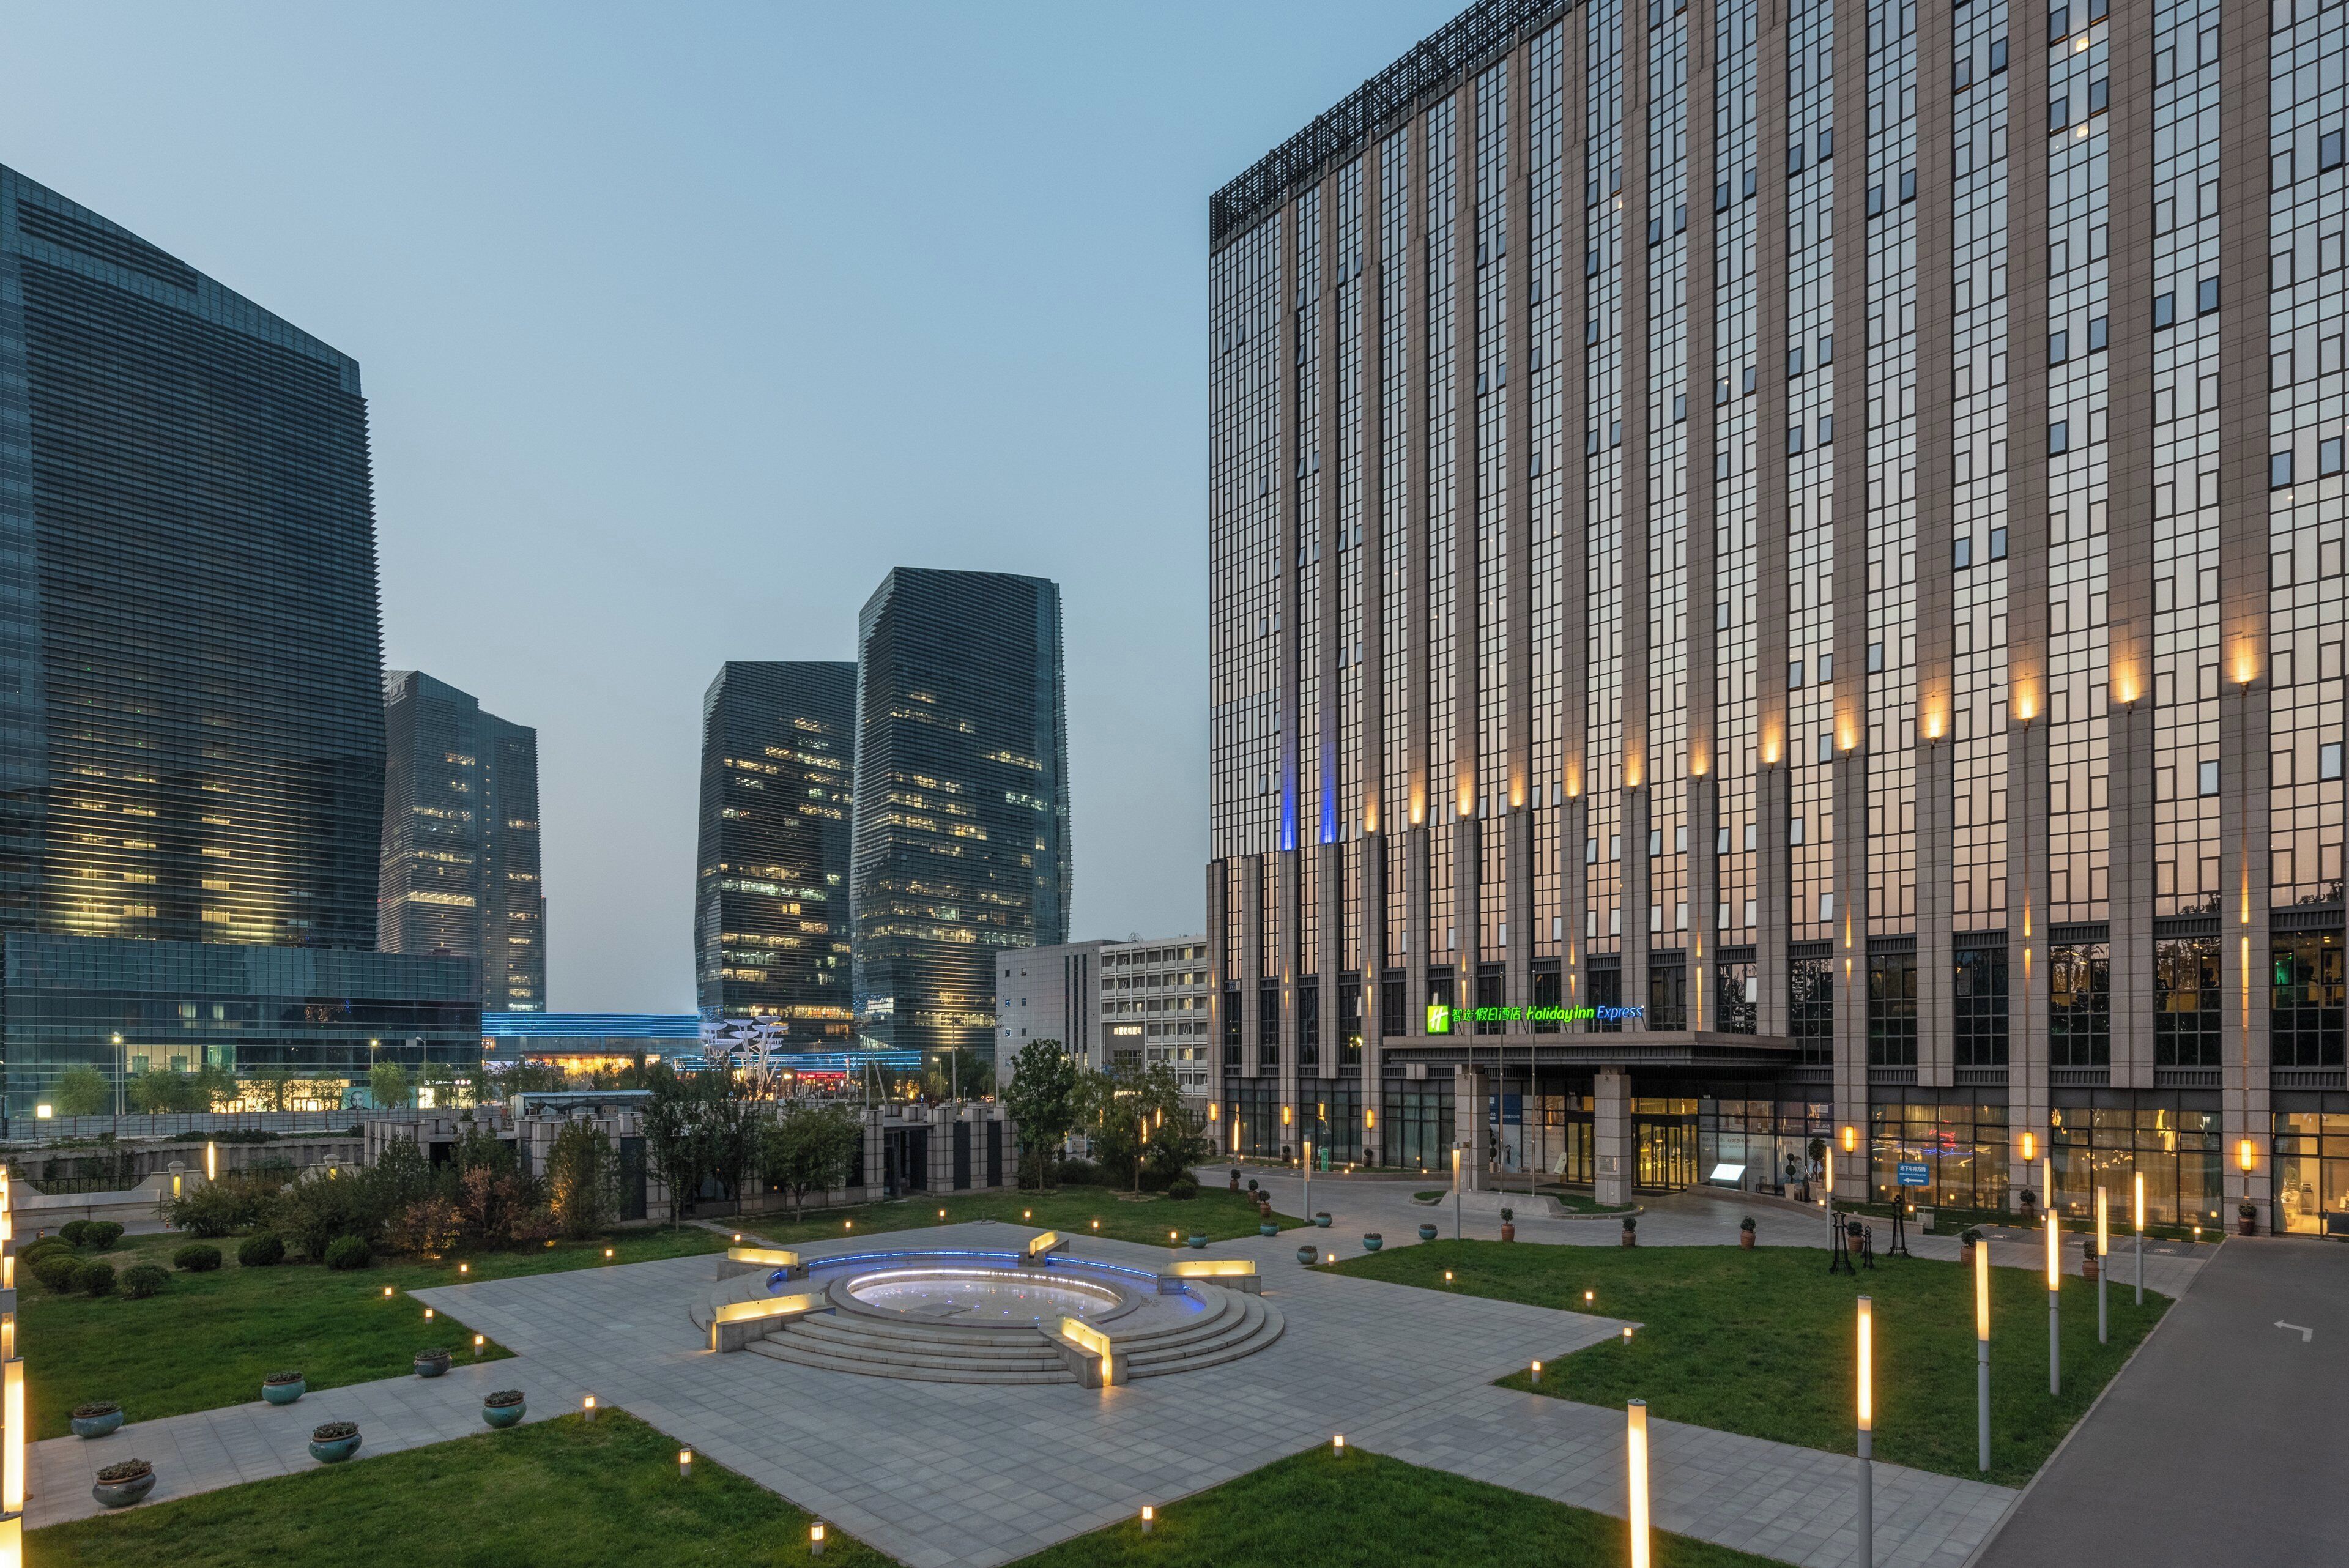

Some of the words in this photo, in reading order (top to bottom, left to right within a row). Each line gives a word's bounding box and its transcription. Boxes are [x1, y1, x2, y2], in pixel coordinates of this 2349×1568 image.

[1526, 1005, 1573, 1023] Holiday
[1574, 1004, 1594, 1019] Inn
[1597, 1005, 1642, 1021] Express
